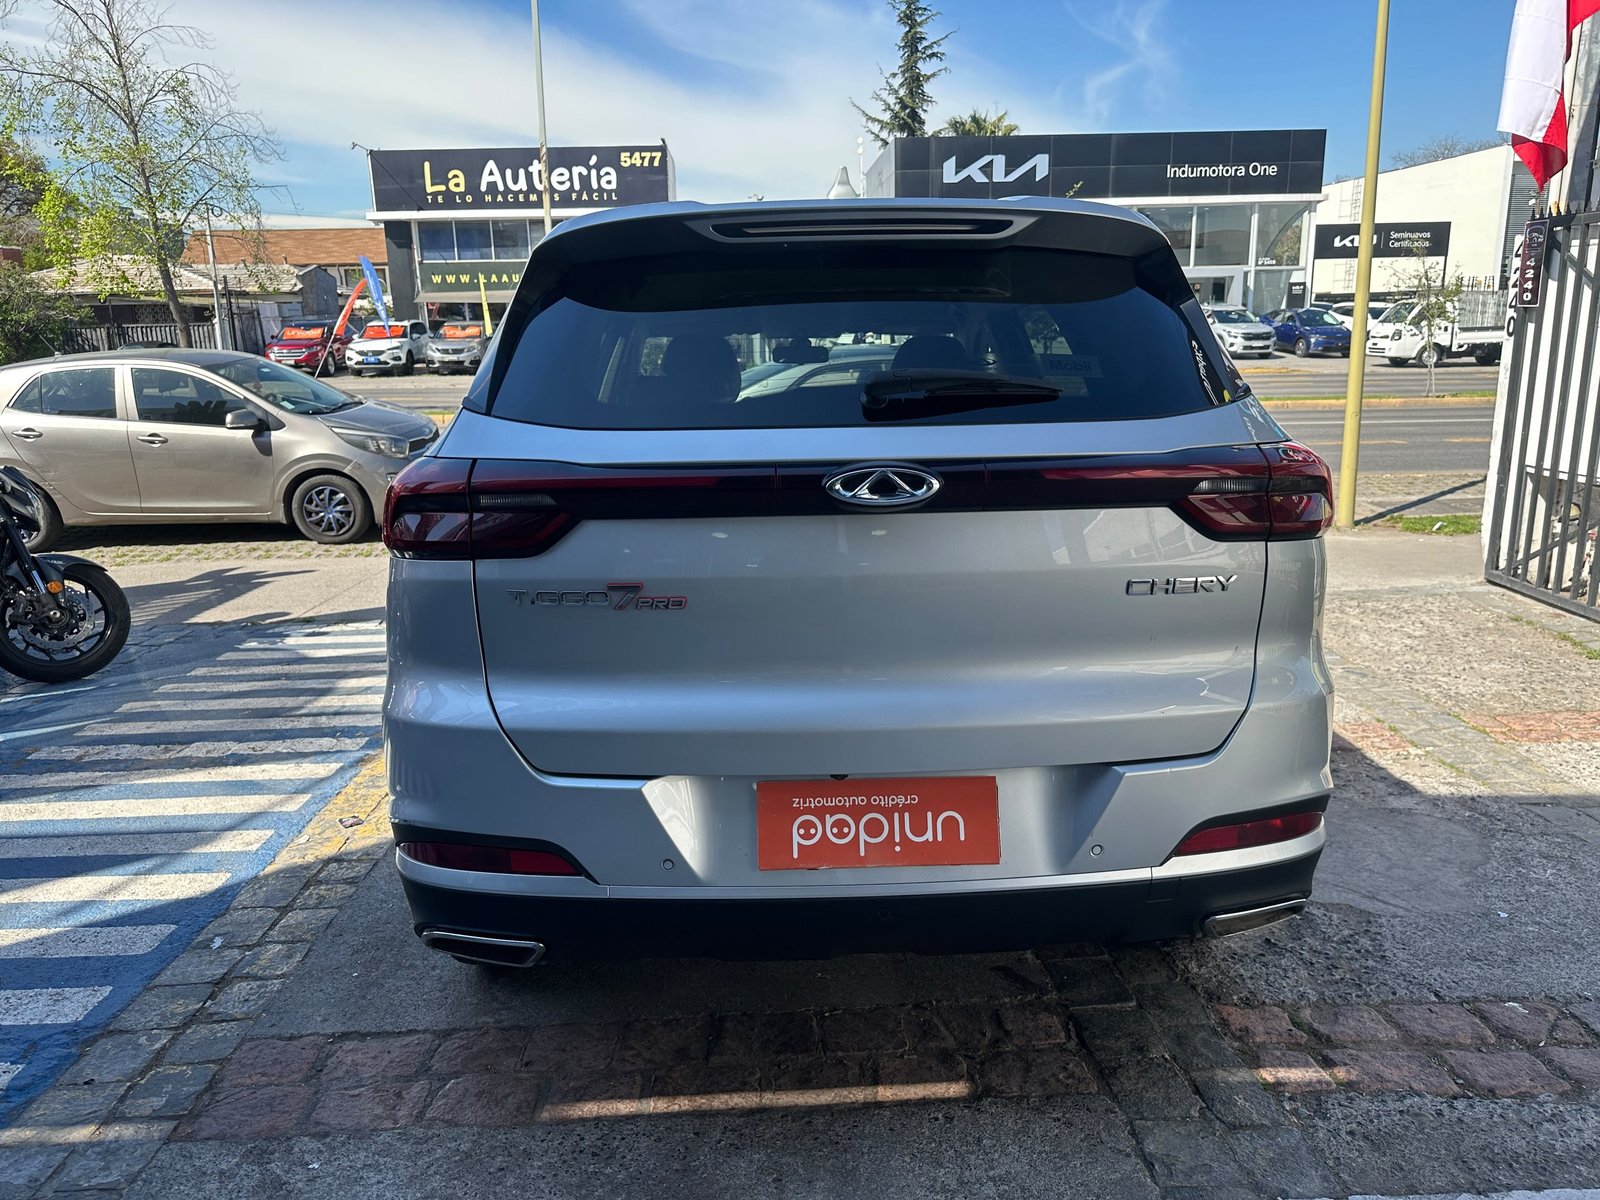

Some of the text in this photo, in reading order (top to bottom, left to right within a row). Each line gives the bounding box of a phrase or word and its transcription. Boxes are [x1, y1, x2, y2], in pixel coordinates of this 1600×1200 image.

[620, 151, 662, 167] 5477
[423, 154, 618, 194] La Autería
[942, 153, 1050, 184] KIA
[1166, 162, 1278, 178] Indumotora One
[426, 190, 618, 204] TE LO HACEMS FÁCIL
[1333, 234, 1378, 248] KI
[1125, 574, 1238, 596] CHERY
[792, 794, 919, 809] crédito automotriz
[792, 810, 966, 859] unidad
